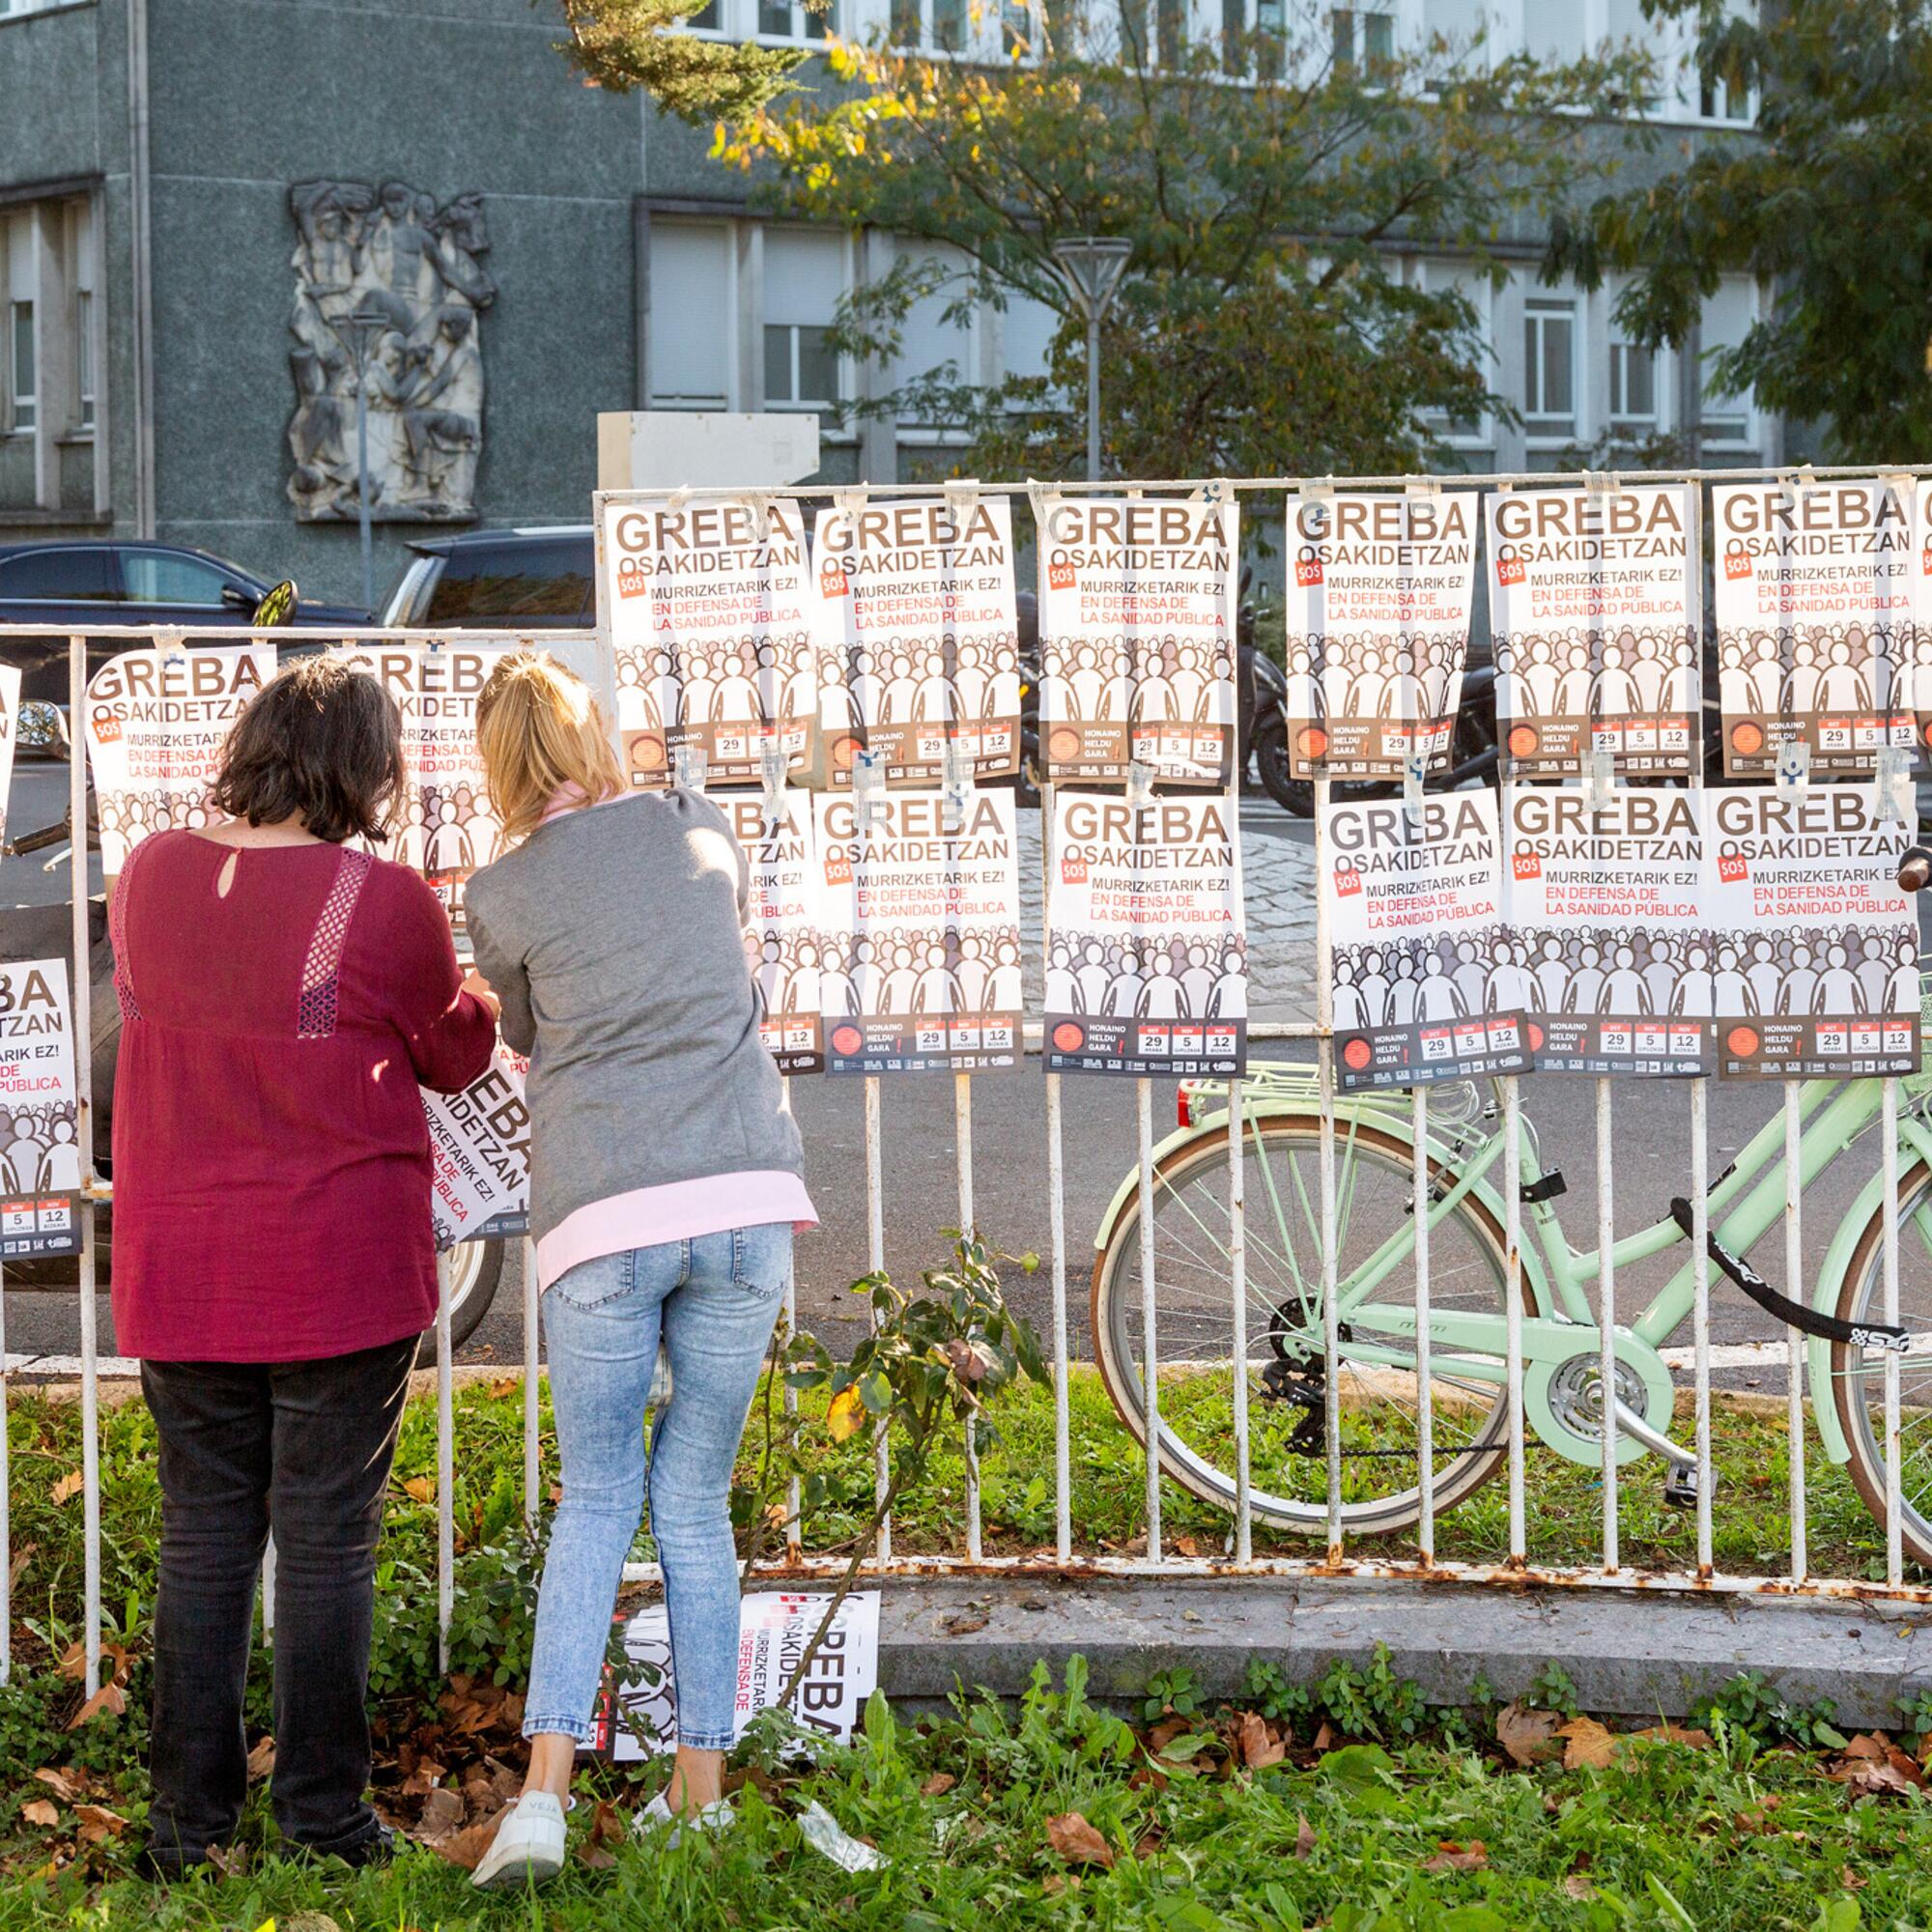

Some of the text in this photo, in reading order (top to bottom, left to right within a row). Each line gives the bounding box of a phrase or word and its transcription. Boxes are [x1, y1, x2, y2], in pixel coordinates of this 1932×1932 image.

[1495, 494, 1682, 539] GREBA
[1724, 488, 1907, 532] GREBA
[616, 505, 795, 553] GREBA
[821, 504, 1000, 553] GREBA
[1050, 506, 1227, 546] GREBA
[1296, 501, 1467, 542] GREBA
[1498, 536, 1687, 563] OSAKIDETZAN
[1726, 530, 1910, 558] OSAKIDETZAN
[619, 546, 800, 577] OSAKIDETZAN
[822, 546, 1004, 577] OSAKIDETZAN
[1051, 549, 1229, 572] OSAKIDETZAN
[1297, 545, 1469, 567] OSAKIDETZAN
[1297, 563, 1321, 579] SOS
[1499, 562, 1523, 579] SOS
[1725, 557, 1749, 573] SOS
[1757, 562, 1910, 582] MURRIZKETARIK EZ!
[1050, 568, 1073, 582] SOS
[1531, 568, 1681, 586] MURRIZKETARIK EZ!
[619, 576, 642, 592] SOS
[651, 577, 797, 601] MURRIZKETARIK EZ!
[822, 576, 846, 592] SOS
[854, 577, 1000, 599] MURRIZKETARIK EZ!
[1081, 582, 1224, 594] MURRIZKETARIK EZ!
[1328, 577, 1464, 589] MURRIZKETARIK EZ!
[1758, 581, 1872, 597] EN DEFENSA DE
[1328, 593, 1436, 606] EN DEFENSA DE
[1532, 585, 1643, 602] EN DEFENSA DE
[652, 596, 761, 615] EN DEFENSA DE
[855, 595, 964, 612] EN DEFENSA DE
[1081, 597, 1188, 609] EN DEFENSA DE
[1533, 606, 1551, 617] LA
[1555, 604, 1617, 616] SANIDAD
[1081, 612, 1098, 623] LA
[1103, 613, 1162, 624] SANIDAD
[89, 654, 263, 700] GREBA
[93, 698, 249, 723] OSAKIDETZA
[145, 749, 206, 762] DEFENSA
[144, 764, 202, 779] SANIDAD
[824, 797, 1004, 840] GREBA
[1065, 803, 1229, 843] GREBA
[1514, 795, 1699, 837] GREBA
[1329, 800, 1489, 852] GREBA
[825, 839, 1009, 866] OSAKIDETZAN
[1065, 844, 1233, 867] OSAKIDETZAN
[1515, 839, 1702, 861] OSAKIDETZAN
[1719, 835, 1910, 862] OSAKIDETZAN
[1335, 839, 1493, 875] OSAKIDETZAN
[827, 864, 850, 879] SOS
[1064, 865, 1085, 878] SOS
[1515, 858, 1538, 872] SOS
[1720, 858, 1745, 874] SOS
[781, 873, 802, 885] EZ!
[858, 870, 1004, 888] MURRIZKETARIK EZ!
[1338, 873, 1359, 891] SOS
[1547, 871, 1696, 884] MURRIZKETARIK EZ!
[1753, 867, 1878, 884] MURRIZKETARIK
[1093, 878, 1229, 891] MURRIZKETARIK EZ!
[1367, 871, 1489, 898] MURRIZKETARIK EZ!
[1754, 884, 1868, 898] EN DEFENSA DE
[751, 891, 768, 902] DE
[859, 888, 967, 902] EN DEFENSA DE
[1092, 894, 1194, 907] EN DEFENSA DE
[1547, 888, 1659, 900] EN DEFENSA DE
[1368, 892, 1457, 913] EN DEFENSA DE
[1546, 903, 1565, 914] LA
[1569, 903, 1631, 916] SANIDAD
[1754, 904, 1775, 916] LA
[1778, 902, 1841, 915] SANIDAD
[859, 906, 877, 918] LA
[881, 904, 941, 917] SANIDAD
[1091, 909, 1108, 921] LA
[1112, 911, 1169, 923] SANIDAD
[1368, 917, 1384, 929] LA
[1387, 911, 1435, 926] SANIDAD
[1089, 1024, 1125, 1033] HONAINO
[1549, 1022, 1587, 1031] HONAINO
[1764, 1025, 1803, 1034] HONAINO
[791, 1032, 807, 1042] 12
[1146, 1037, 1161, 1046] 29
[1183, 1037, 1191, 1046] 5
[1213, 1037, 1229, 1047] 12
[1375, 1033, 1409, 1044] HONAINO
[1466, 1037, 1474, 1046] 5
[1495, 1031, 1511, 1042] 12
[1607, 1036, 1624, 1044] 29
[1647, 1036, 1654, 1045] 5
[1678, 1037, 1693, 1046] 12
[1823, 1036, 1840, 1045] 29
[1861, 1035, 1869, 1044] 5
[1890, 1034, 1906, 1043] 12
[35, 1044, 59, 1058] EZ!
[1376, 1044, 1402, 1055] HELDU
[1429, 1039, 1445, 1052] 29
[0, 1064, 20, 1077] DE
[440, 1161, 461, 1182] DE
[474, 1178, 496, 1203] EZ!
[14, 1214, 22, 1225] 5
[46, 1211, 63, 1222] 12
[737, 1640, 753, 1690] DEFENSA
[736, 1693, 749, 1711] DE
[529, 1801, 557, 1814] VEJA
